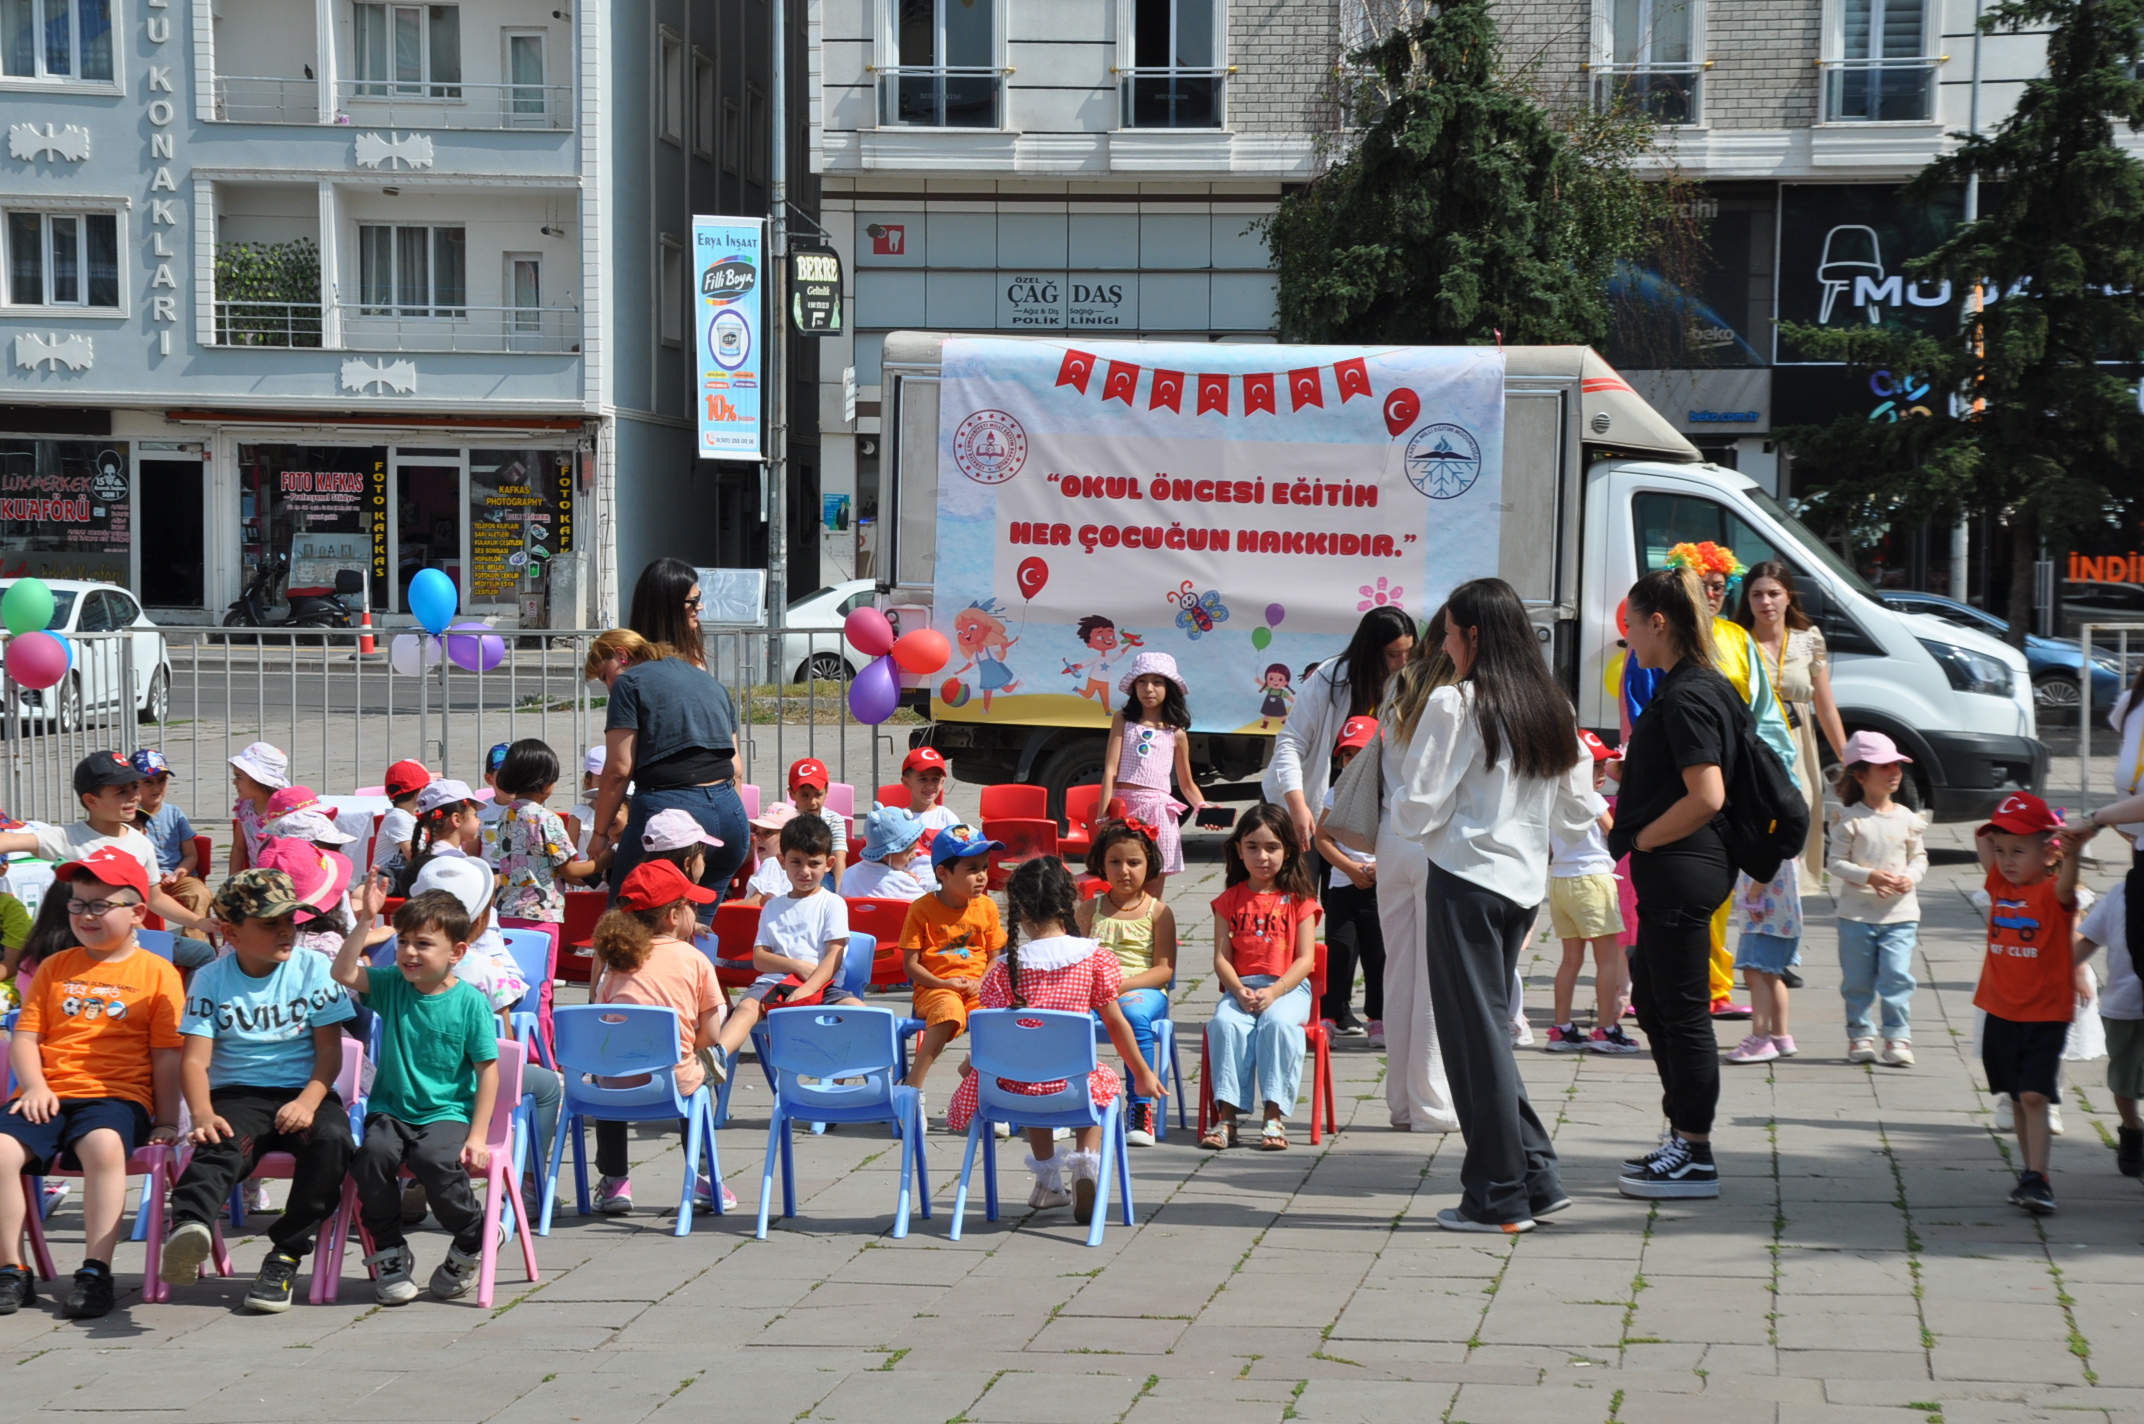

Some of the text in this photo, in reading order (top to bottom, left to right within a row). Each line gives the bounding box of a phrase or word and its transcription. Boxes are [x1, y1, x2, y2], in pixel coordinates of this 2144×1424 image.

[148, 0, 176, 356] U KONAKLARI
[704, 268, 754, 291] Filli Boya
[796, 255, 838, 283] BERRE
[1014, 276, 1041, 284] ÖZEL
[806, 286, 831, 296] Gelinlik
[1007, 280, 1123, 308] ÇAĞ DAŞ
[1012, 316, 1119, 325] POLİK LİNİĞİ
[1023, 308, 1039, 316] Ağız
[1048, 308, 1060, 316] Diş
[1069, 308, 1095, 316] Sağlığı
[705, 393, 738, 422] 10%
[1689, 411, 1760, 422] beko.com.tr
[989, 422, 1004, 431] MİLLİ
[1407, 443, 1418, 459] KARS
[1419, 428, 1434, 440] MİLLİ
[1434, 425, 1455, 433] EĞİTİM
[281, 472, 363, 492] FOTO KAFKAS
[498, 486, 530, 494] KAFKAS
[559, 466, 571, 509] FOTO
[1150, 473, 1265, 504] ÖNCESİ
[1271, 477, 1379, 508] EĞİTİM
[0, 493, 91, 522] KUAFÖRÜ
[290, 493, 355, 502] Profesyonel Stüdyo
[486, 498, 543, 506] PHOTOGRAPHY
[373, 462, 385, 577] FOTO KAFKAS
[1009, 521, 1072, 546] HER
[1078, 521, 1230, 554] ÇOCUĞUN
[2069, 551, 2144, 584] İNDİ
[1230, 913, 1288, 932] STARS
[2007, 946, 2038, 958] CLUB
[217, 997, 309, 1031] GUILD
